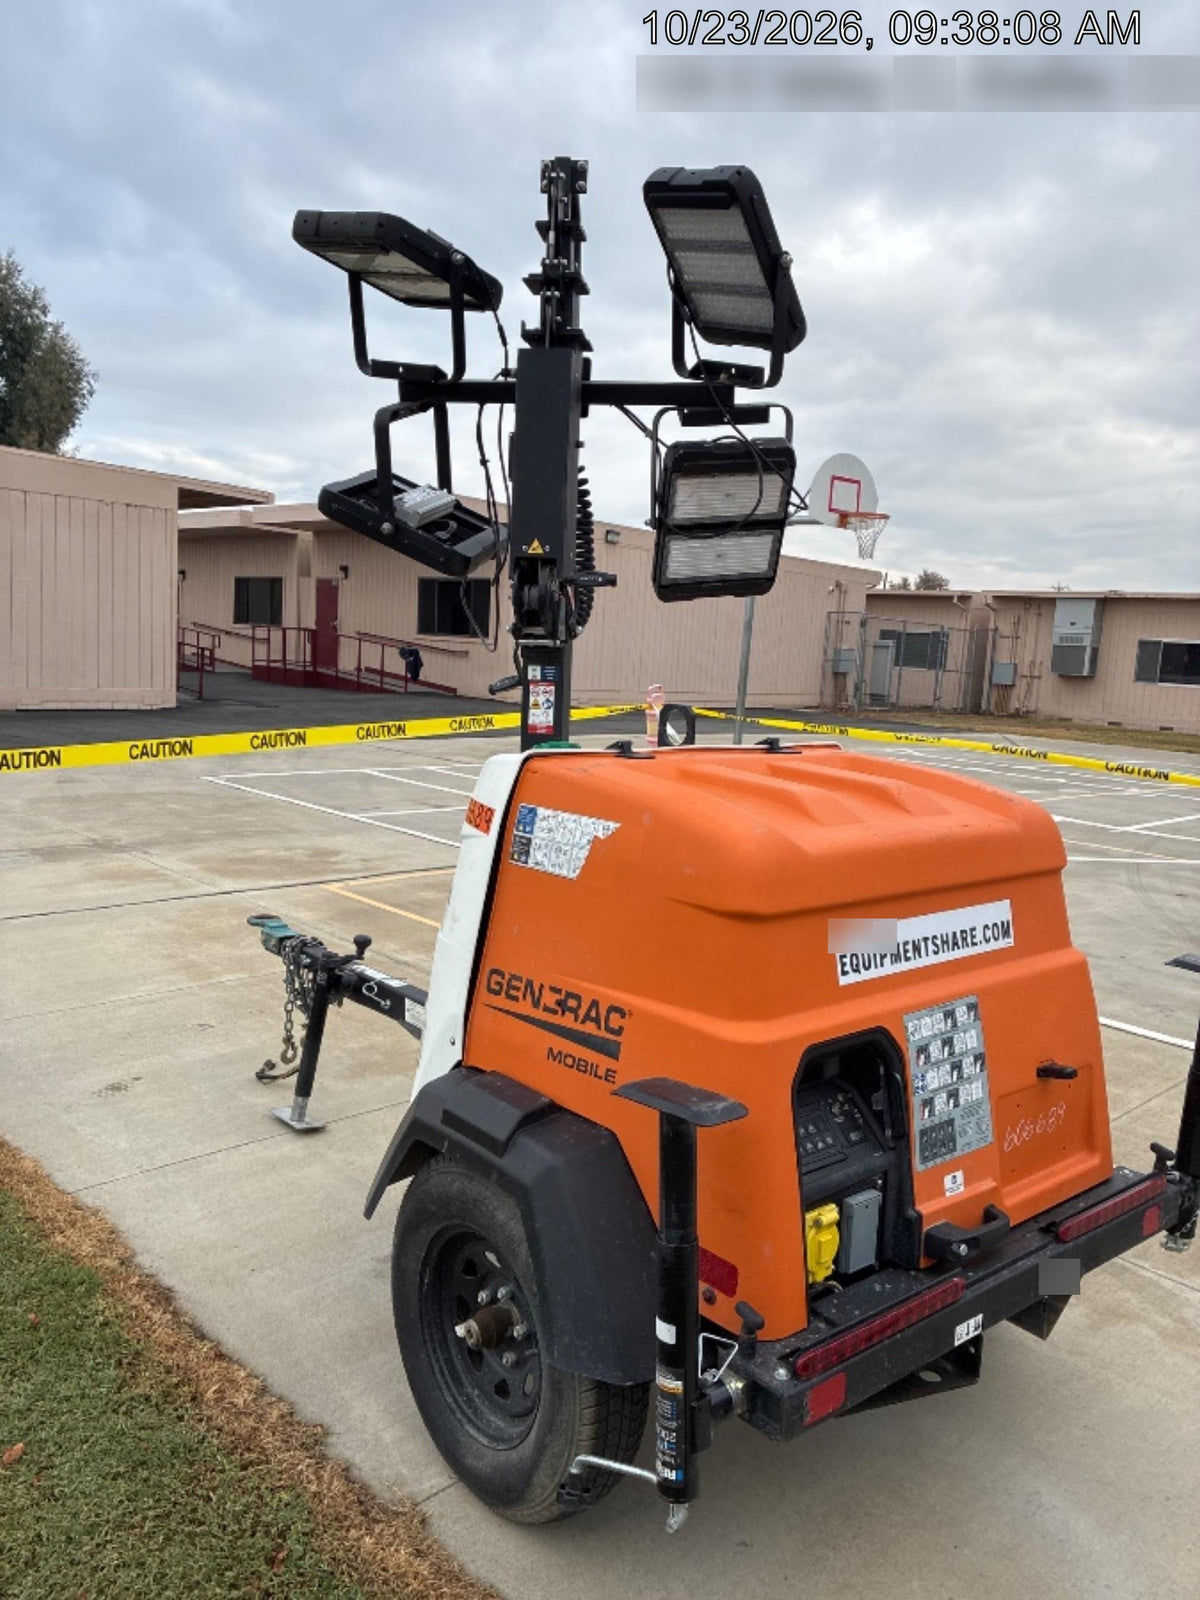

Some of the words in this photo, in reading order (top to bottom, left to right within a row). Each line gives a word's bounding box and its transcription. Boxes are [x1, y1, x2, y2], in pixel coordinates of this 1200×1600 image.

[250, 731, 307, 749] CAUTION
[356, 722, 407, 740] CAUTION
[129, 740, 193, 760] CAUTION
[485, 968, 627, 1037] GENERAC
[546, 1046, 618, 1085] MOBILE
